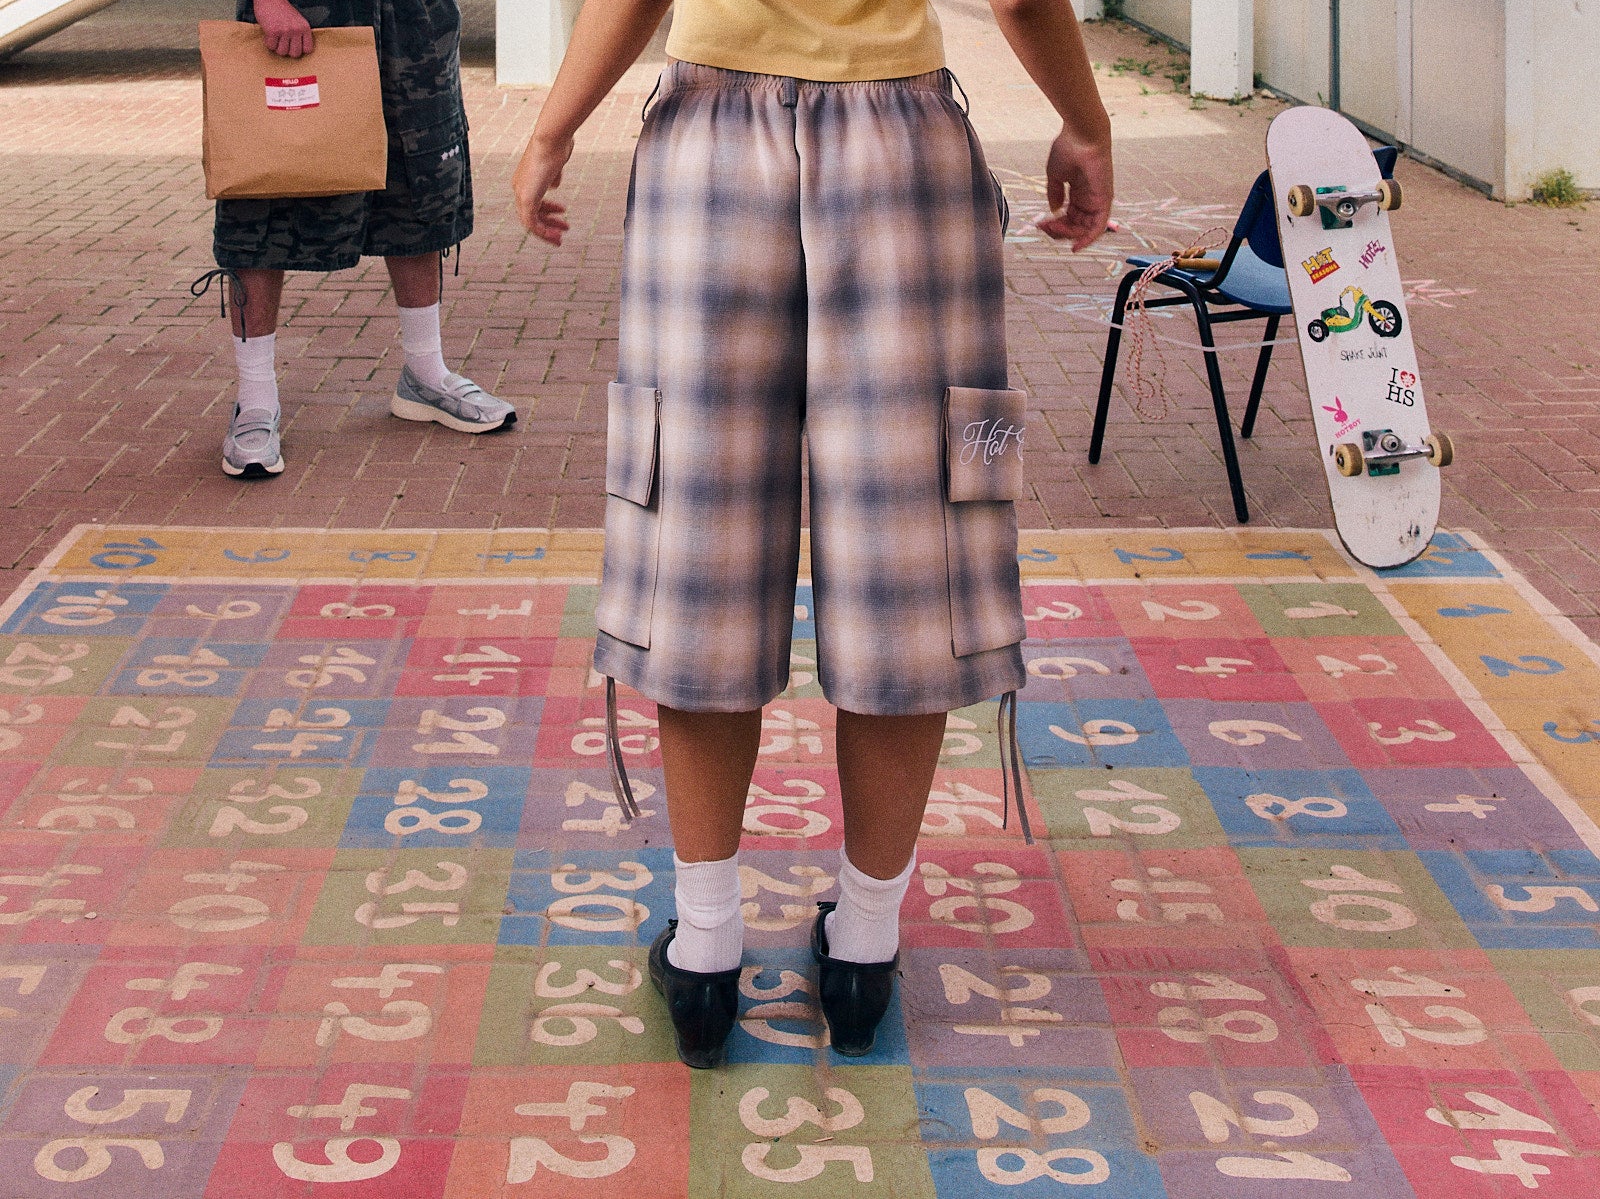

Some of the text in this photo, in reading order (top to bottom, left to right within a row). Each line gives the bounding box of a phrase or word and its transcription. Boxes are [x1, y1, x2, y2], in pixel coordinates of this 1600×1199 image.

[1385, 383, 1415, 408] HS
[1389, 367, 1399, 384] I
[960, 417, 1014, 465] Hot
[1334, 418, 1362, 439] HOTBOY
[90, 537, 166, 569] 10
[223, 548, 291, 563] 9
[1113, 548, 1185, 564] 2
[41, 590, 129, 626] 10
[186, 600, 262, 621] 9
[320, 602, 396, 620] 8
[457, 600, 533, 621] 7
[1141, 600, 1221, 622] 2
[1283, 601, 1359, 620] 1
[1436, 603, 1513, 618] 1
[135, 648, 230, 688] 18
[285, 648, 376, 688] 16
[433, 646, 521, 686] 14
[1176, 656, 1254, 678] 4
[1315, 654, 1398, 679] 2
[1480, 655, 1566, 678] 2
[95, 706, 197, 751] 27
[252, 708, 351, 757] 24
[412, 707, 506, 755] 21
[571, 708, 660, 755] 18
[1367, 719, 1456, 744] 3
[208, 777, 321, 837] 32
[384, 779, 488, 836] 28
[562, 779, 656, 836] 24
[1075, 779, 1182, 836] 12
[1244, 793, 1348, 821] 8
[1425, 794, 1507, 819] 4
[168, 860, 286, 932] 40
[354, 861, 468, 928] 35
[546, 861, 653, 932] 30
[920, 862, 1035, 934] 20
[1111, 867, 1224, 922] 15
[1300, 864, 1418, 932] 10
[1486, 884, 1600, 913] 5
[104, 961, 244, 1044] 48
[315, 963, 446, 1041] 42
[531, 960, 645, 1046] 36
[938, 963, 1064, 1047] 24
[1149, 971, 1279, 1043] 18
[1350, 967, 1488, 1047] 12
[34, 1085, 193, 1183] 56
[272, 1083, 414, 1183] 49
[507, 1081, 636, 1184] 42
[739, 1086, 874, 1183] 35
[963, 1088, 1111, 1186] 28
[1188, 1090, 1352, 1182] 21
[1425, 1091, 1570, 1189] 14
